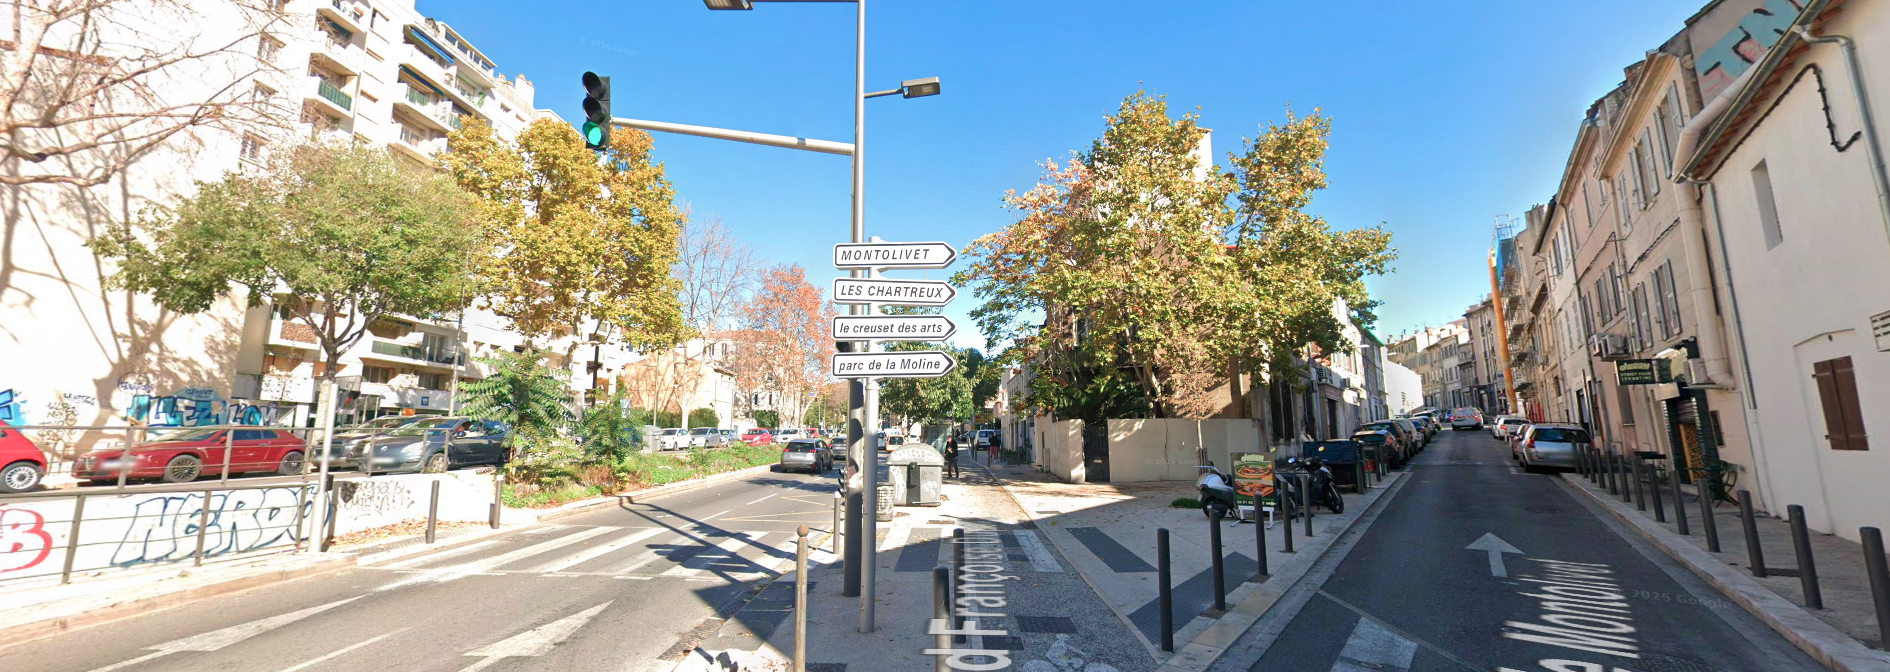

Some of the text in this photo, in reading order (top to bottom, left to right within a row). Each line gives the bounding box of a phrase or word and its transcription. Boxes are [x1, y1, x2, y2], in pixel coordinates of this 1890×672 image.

[841, 249, 930, 261] MONTOLIVET
[841, 285, 944, 298] LES CHARTREUX
[839, 322, 943, 333] le creuset des arts
[839, 358, 941, 373] parc de la Moline
